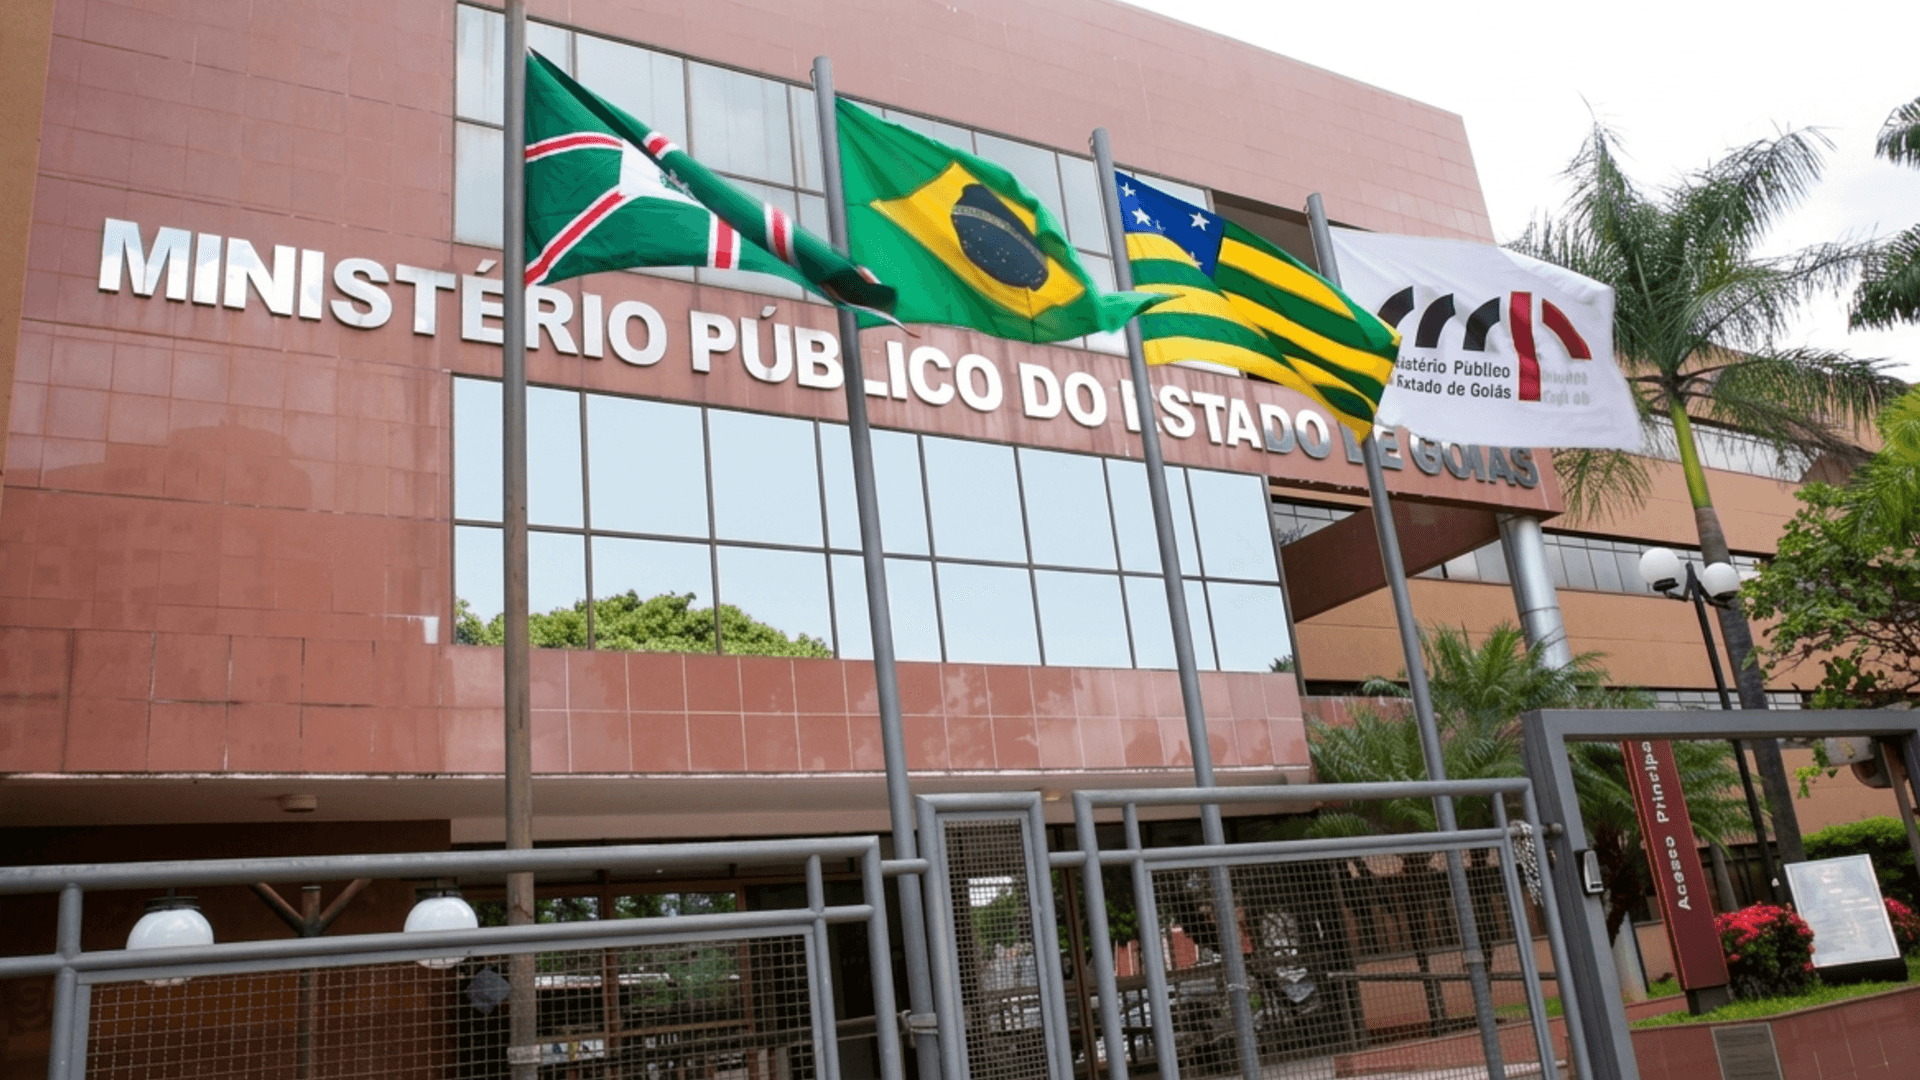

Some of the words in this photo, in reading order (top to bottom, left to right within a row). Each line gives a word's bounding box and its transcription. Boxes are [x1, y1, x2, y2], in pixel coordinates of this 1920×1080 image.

[98, 217, 668, 366] MINISTÉRIO
[1018, 362, 1107, 428] DO
[1396, 356, 1447, 374] istério
[1447, 380, 1466, 396] de
[1642, 741, 1669, 823] Principa
[1665, 836, 1692, 911] Acesso
